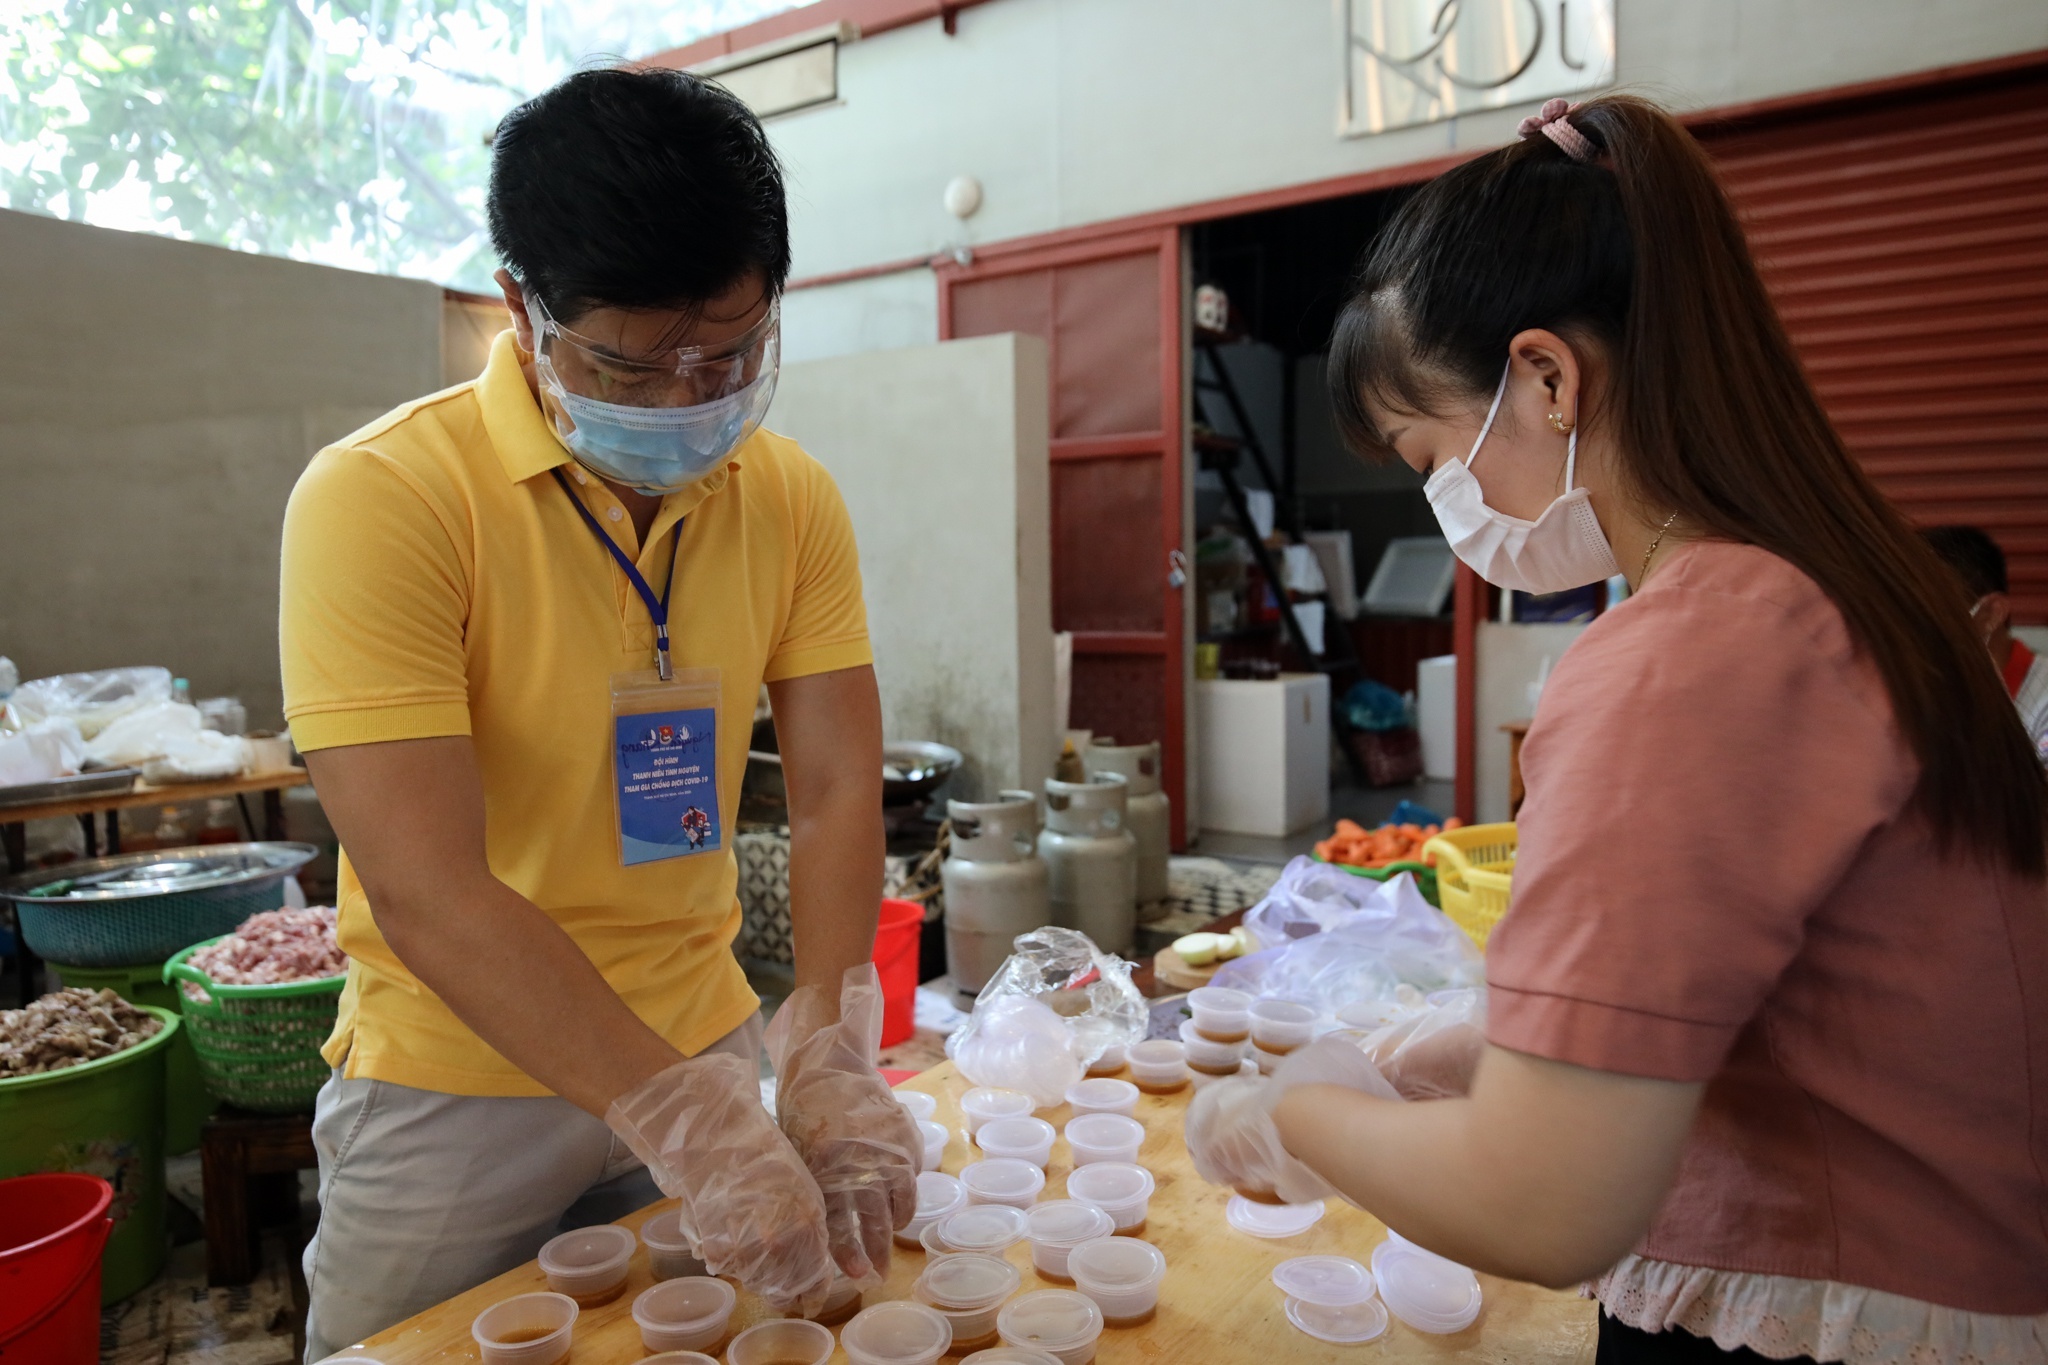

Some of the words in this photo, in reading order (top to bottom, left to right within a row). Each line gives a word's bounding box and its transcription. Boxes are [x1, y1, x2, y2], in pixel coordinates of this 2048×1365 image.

[632, 771, 651, 780] THANH
[651, 769, 664, 778] NIÊN
[665, 768, 677, 776] TÌNH
[678, 765, 699, 775] NGUYỆN
[624, 785, 640, 793] THAM
[651, 779, 670, 790] CHỐNG
[684, 776, 708, 785] COVID-19
